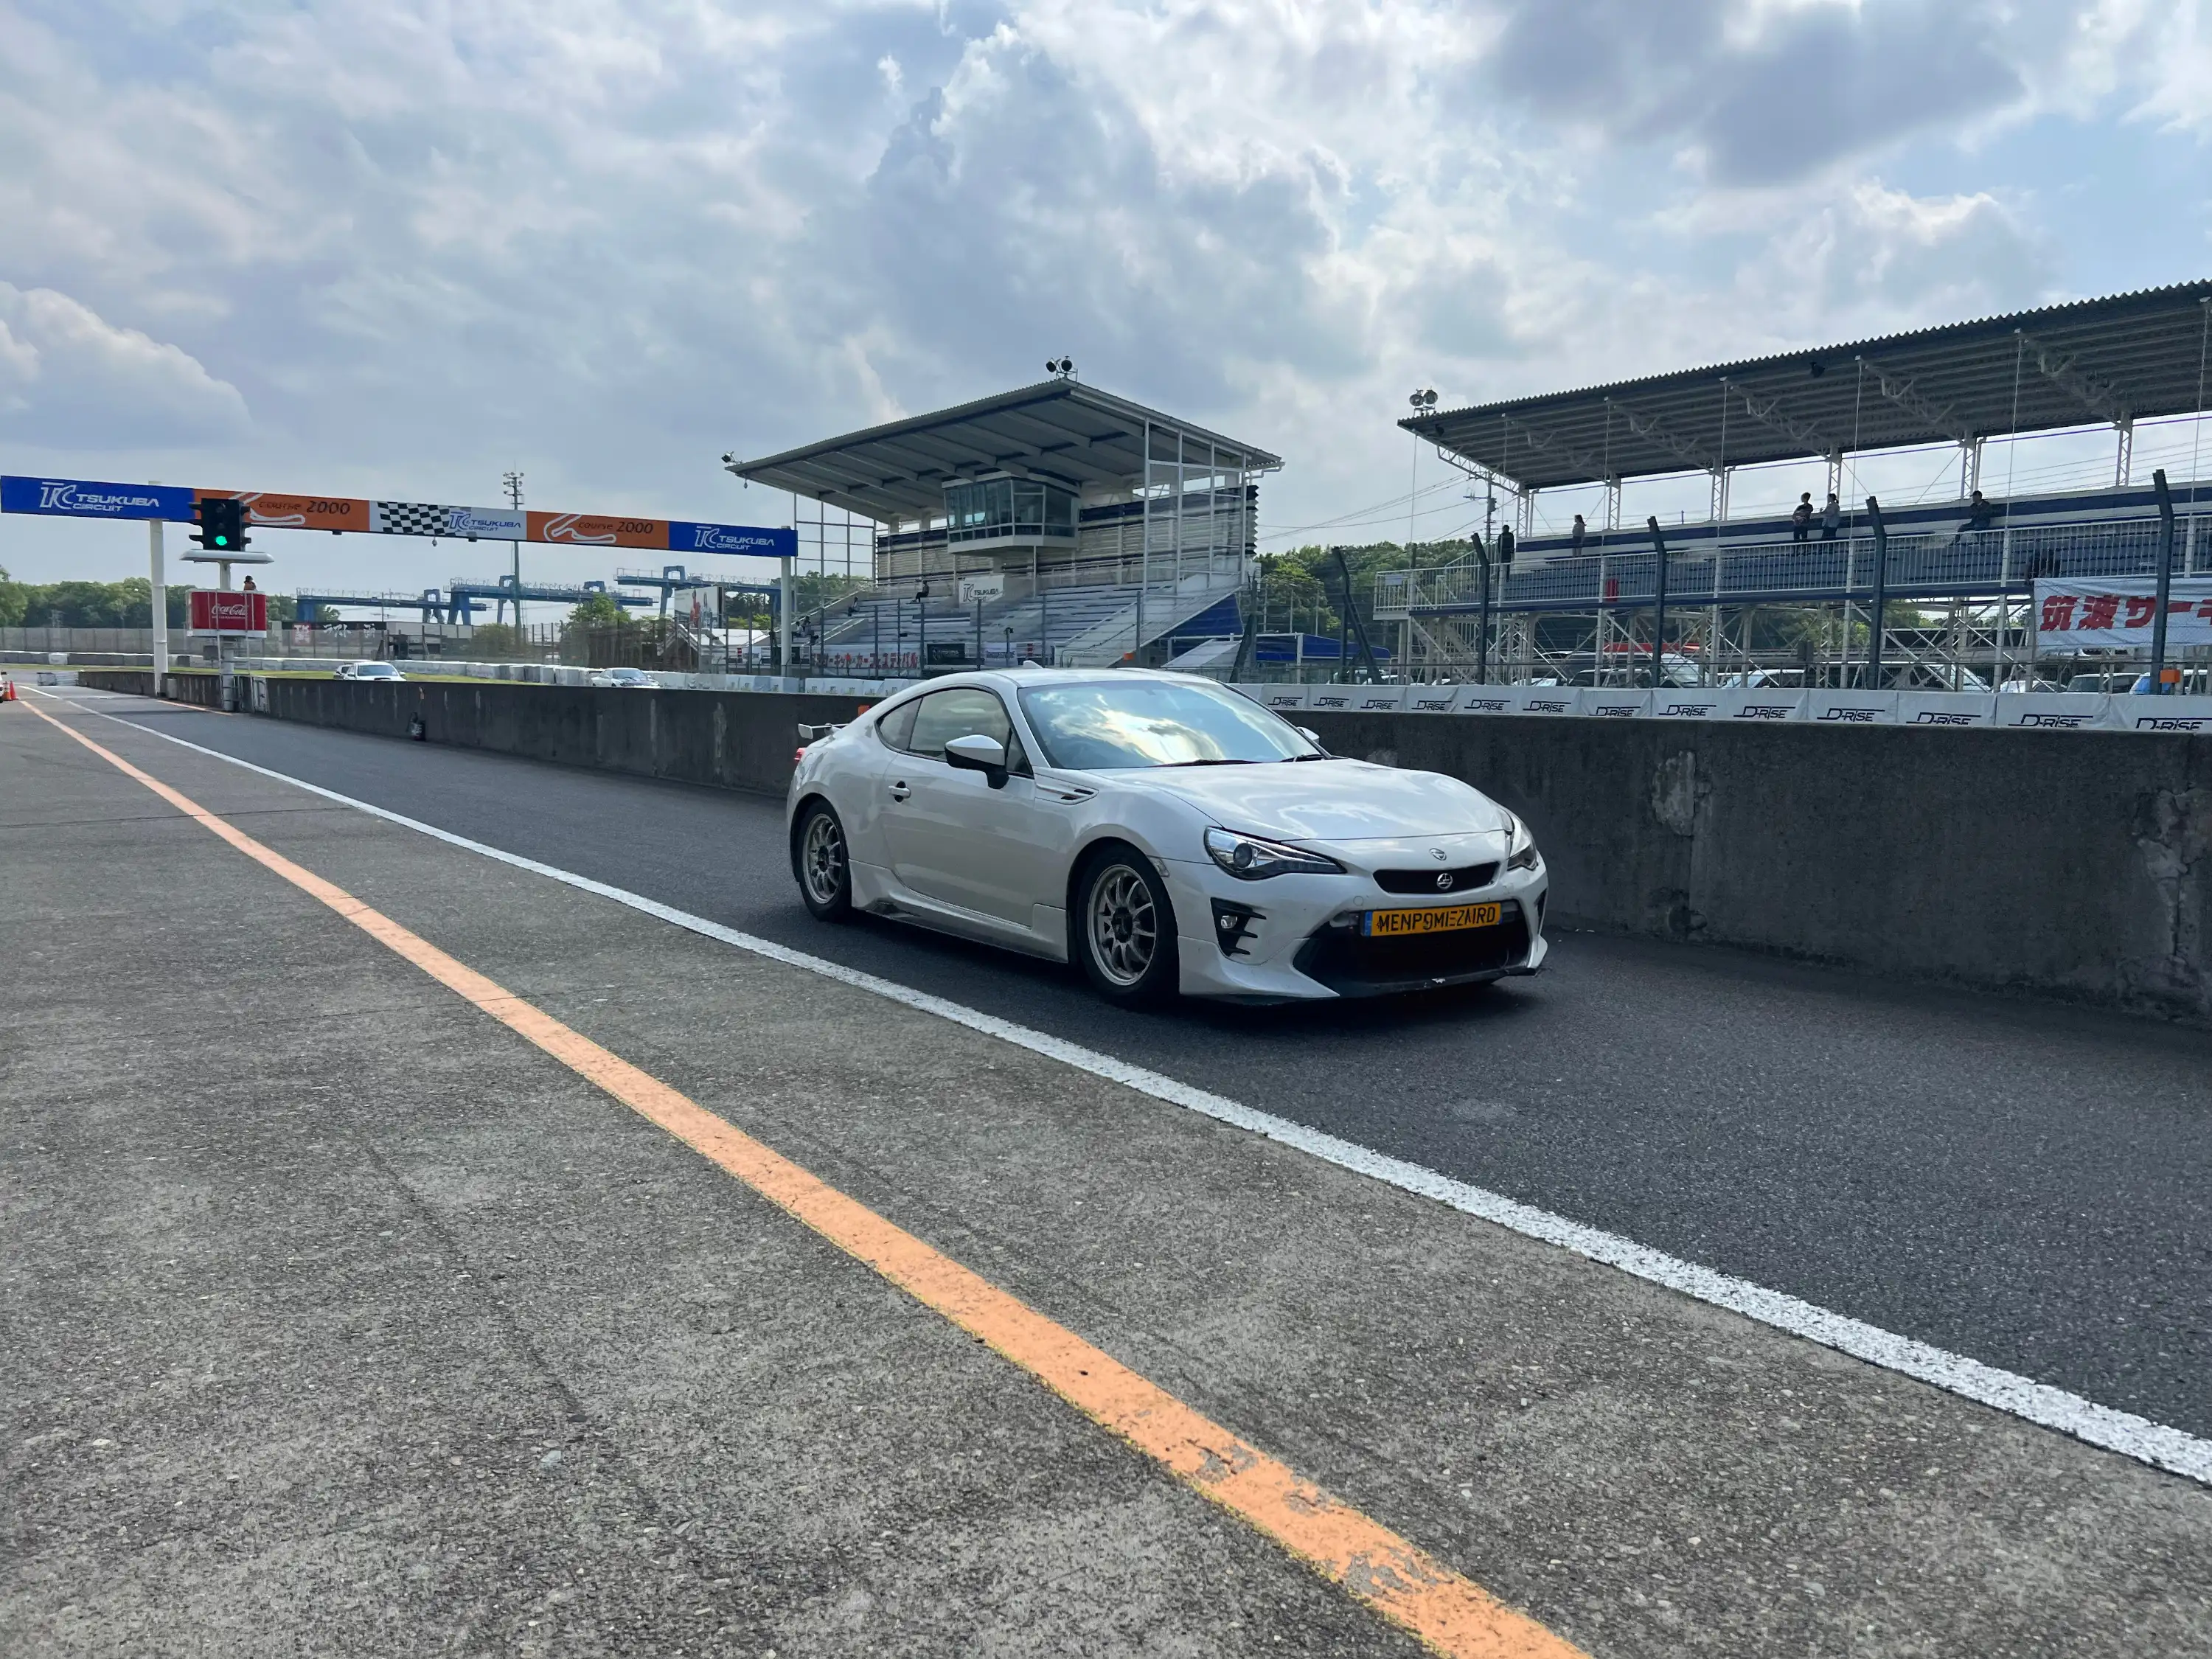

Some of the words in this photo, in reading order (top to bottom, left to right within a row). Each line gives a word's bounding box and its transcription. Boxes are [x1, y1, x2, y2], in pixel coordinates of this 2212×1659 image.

[76, 493, 160, 507] TSUKUBA
[72, 503, 124, 512] CIRCUIT
[306, 500, 350, 515] 2000
[471, 519, 521, 528] TSUKUBA
[578, 521, 613, 529] course
[616, 521, 653, 534] 2000
[719, 535, 775, 546] TSUKUBA
